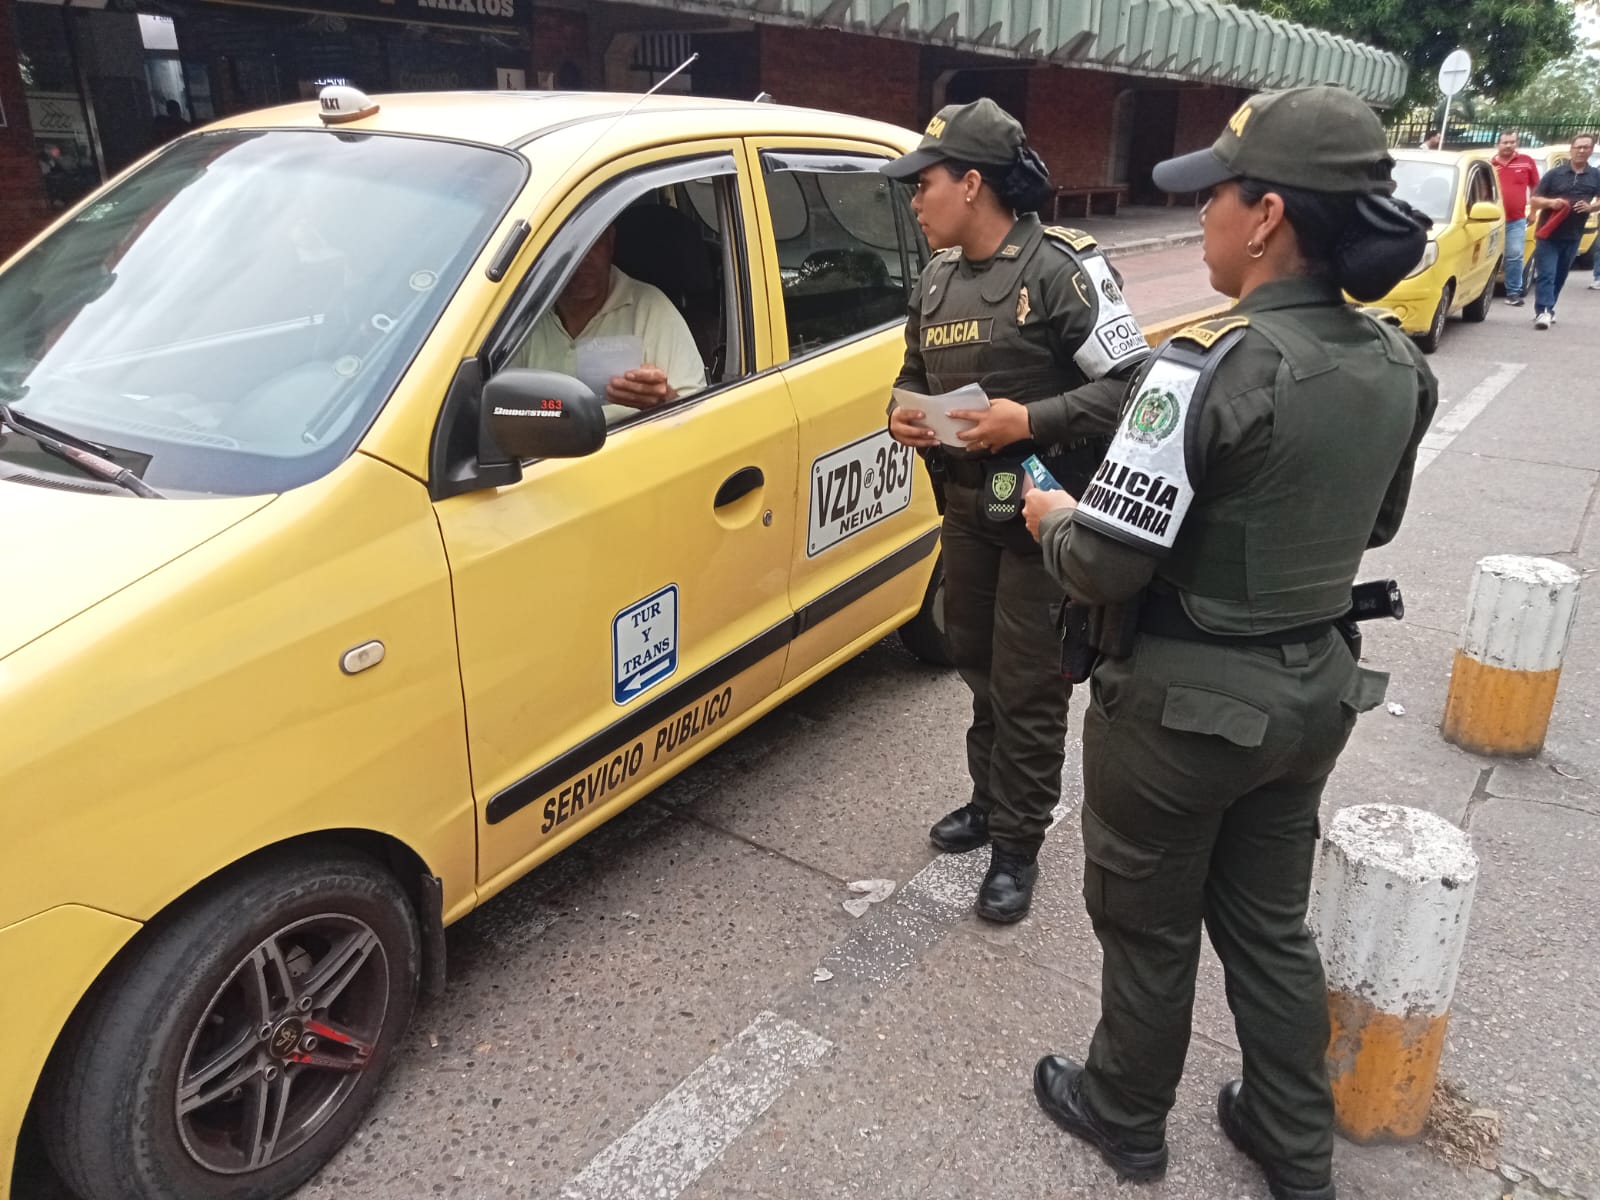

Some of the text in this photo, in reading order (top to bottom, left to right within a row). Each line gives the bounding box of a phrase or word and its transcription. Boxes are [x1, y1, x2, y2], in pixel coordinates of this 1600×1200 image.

[925, 320, 979, 347] POLICIA
[541, 399, 562, 411] 363
[817, 441, 909, 528] VZD 363
[1095, 459, 1179, 511] OLICÍA
[839, 501, 883, 535] NEIVA
[631, 602, 662, 628] TUR
[641, 627, 652, 643] Y
[623, 637, 670, 675] TRANS
[541, 686, 732, 834] SERVICIO PUBLICO
